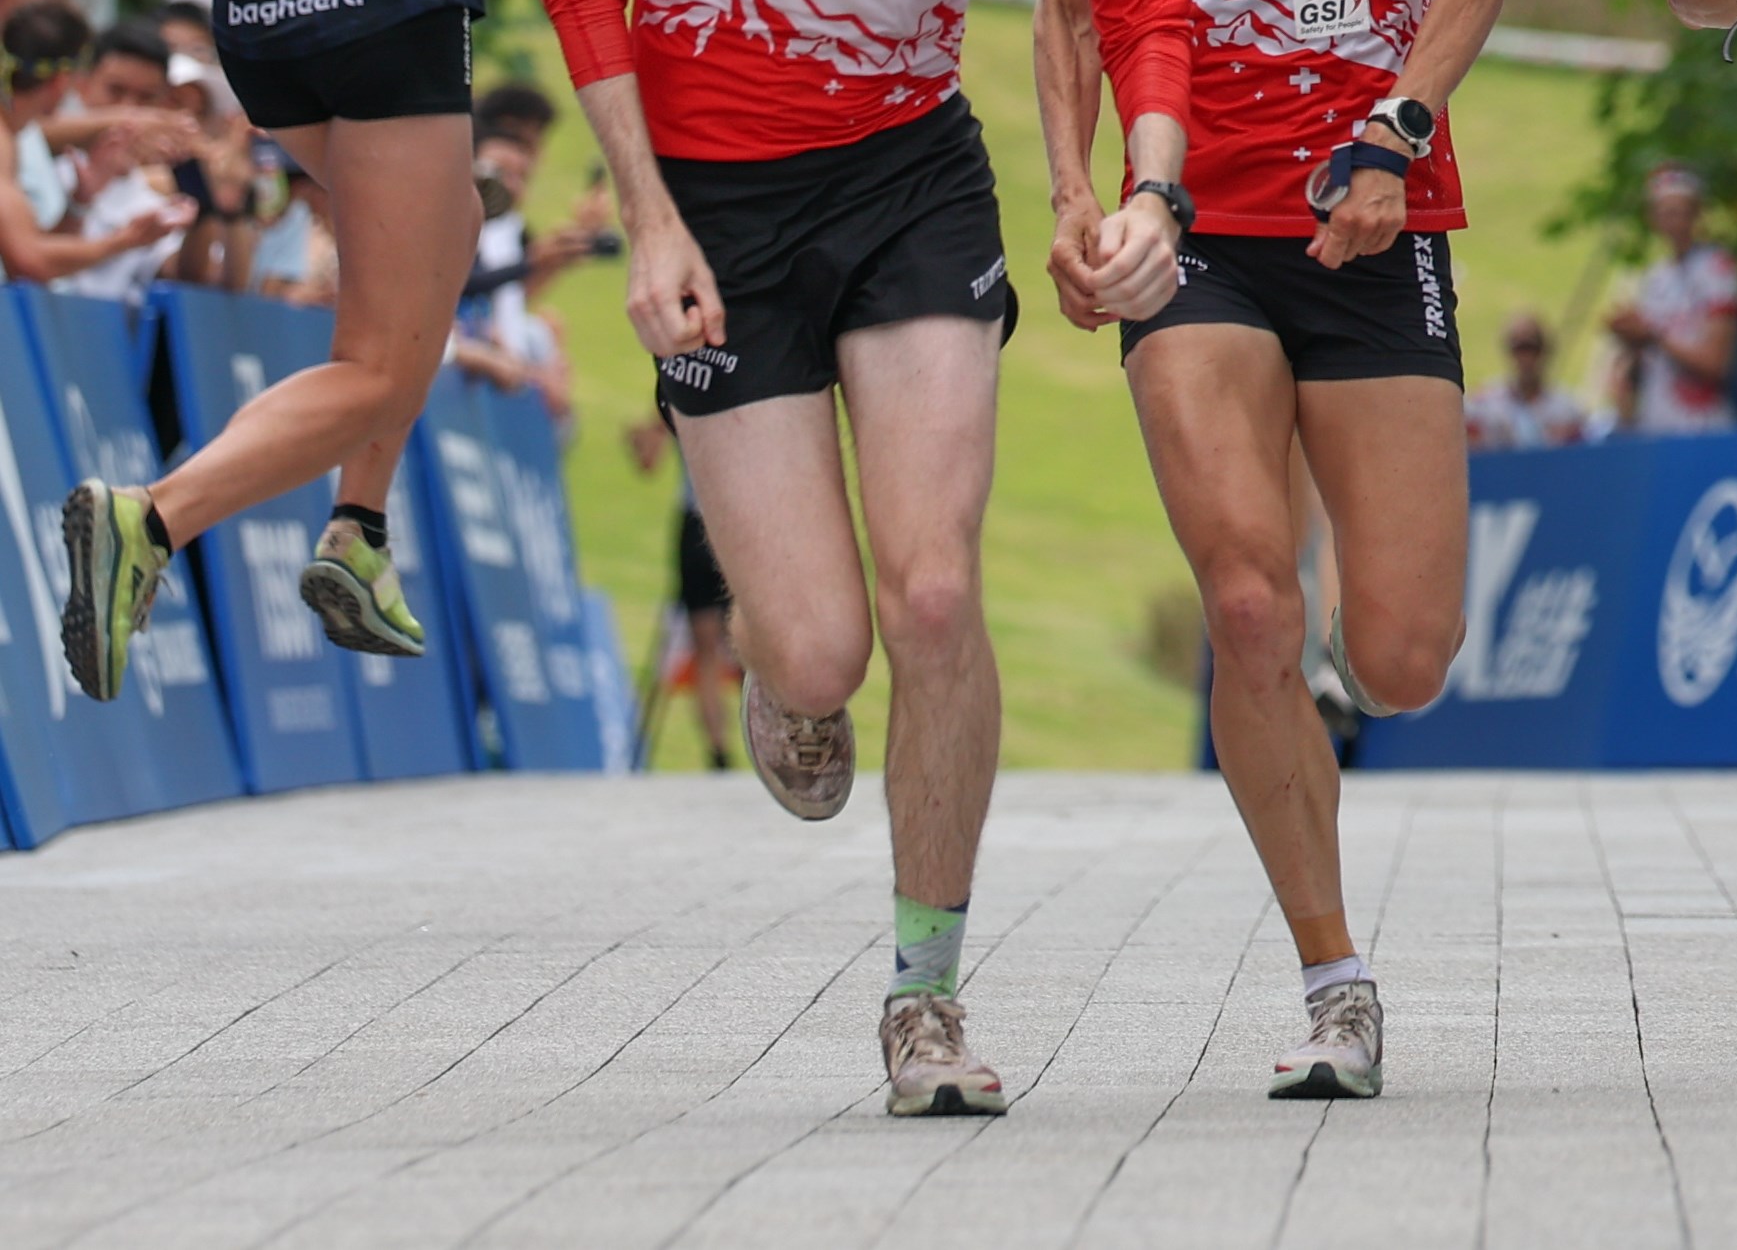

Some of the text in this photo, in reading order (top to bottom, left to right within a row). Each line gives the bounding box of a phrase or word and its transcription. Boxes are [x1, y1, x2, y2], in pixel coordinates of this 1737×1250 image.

[1300, 0, 1346, 25] GSI
[1301, 25, 1324, 35] Safety
[1325, 23, 1336, 31] for
[1413, 233, 1448, 340] TRIMTEX
